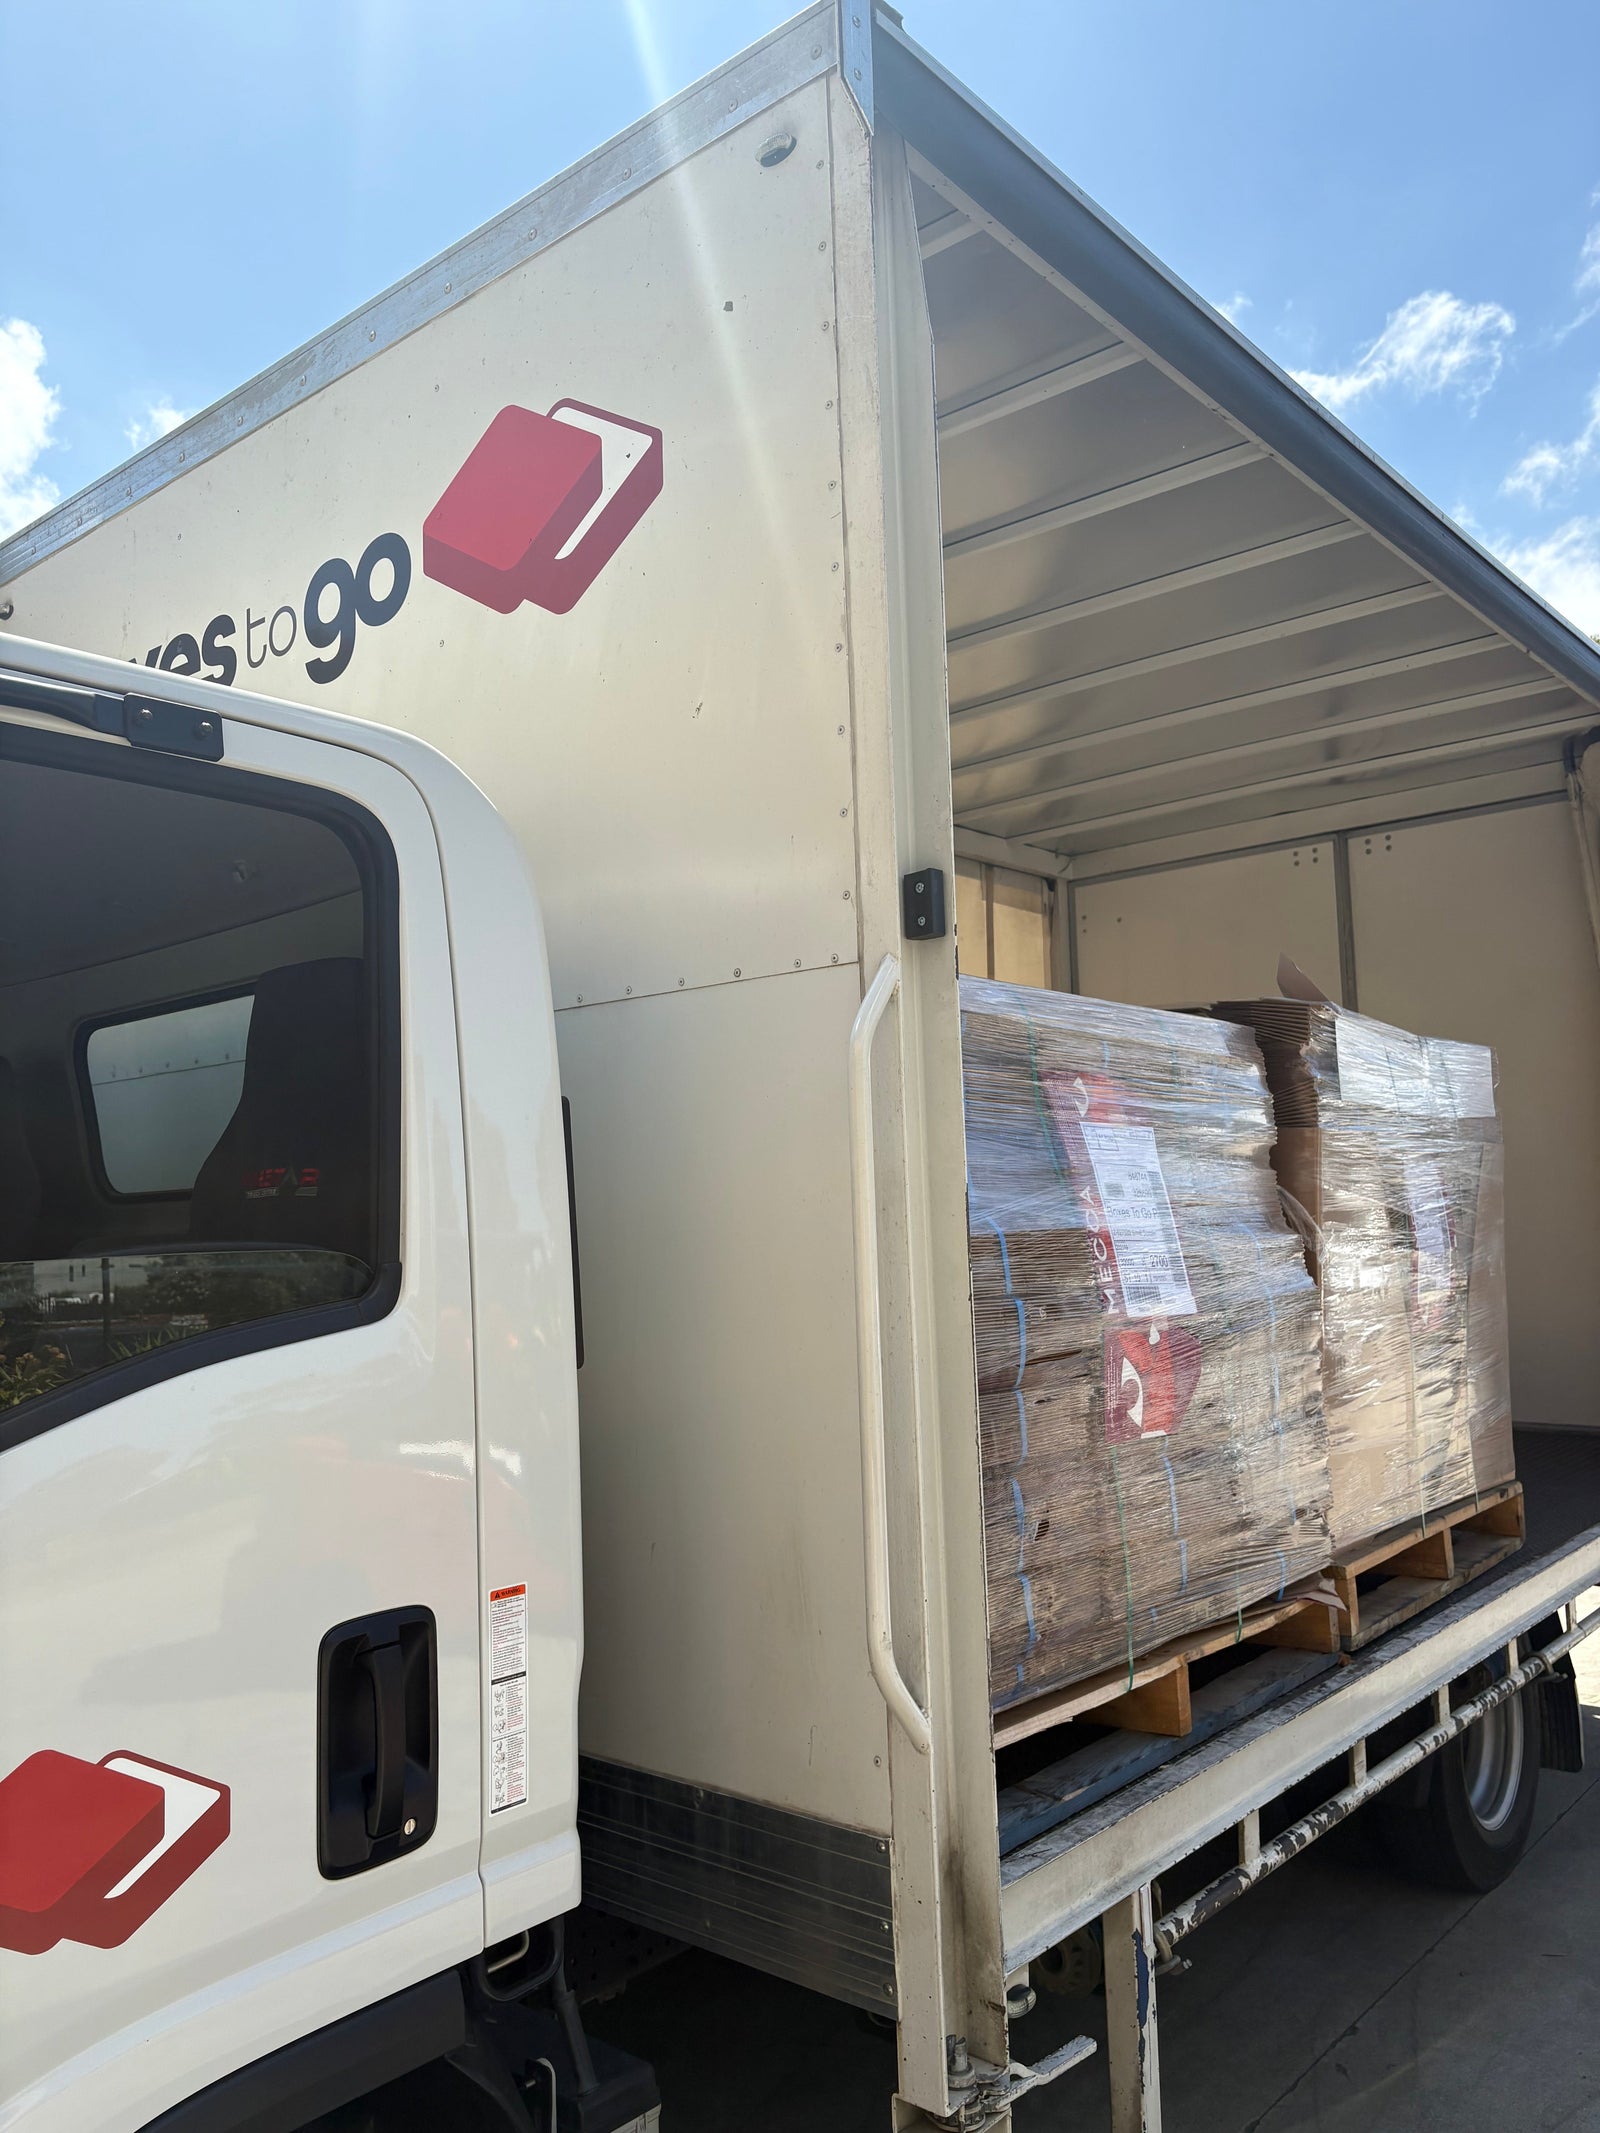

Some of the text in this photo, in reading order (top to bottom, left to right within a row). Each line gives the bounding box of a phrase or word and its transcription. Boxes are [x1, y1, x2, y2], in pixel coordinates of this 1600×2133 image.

[246, 605, 298, 669] to
[304, 532, 412, 684] go
[1149, 1254, 1169, 1268] 2700
